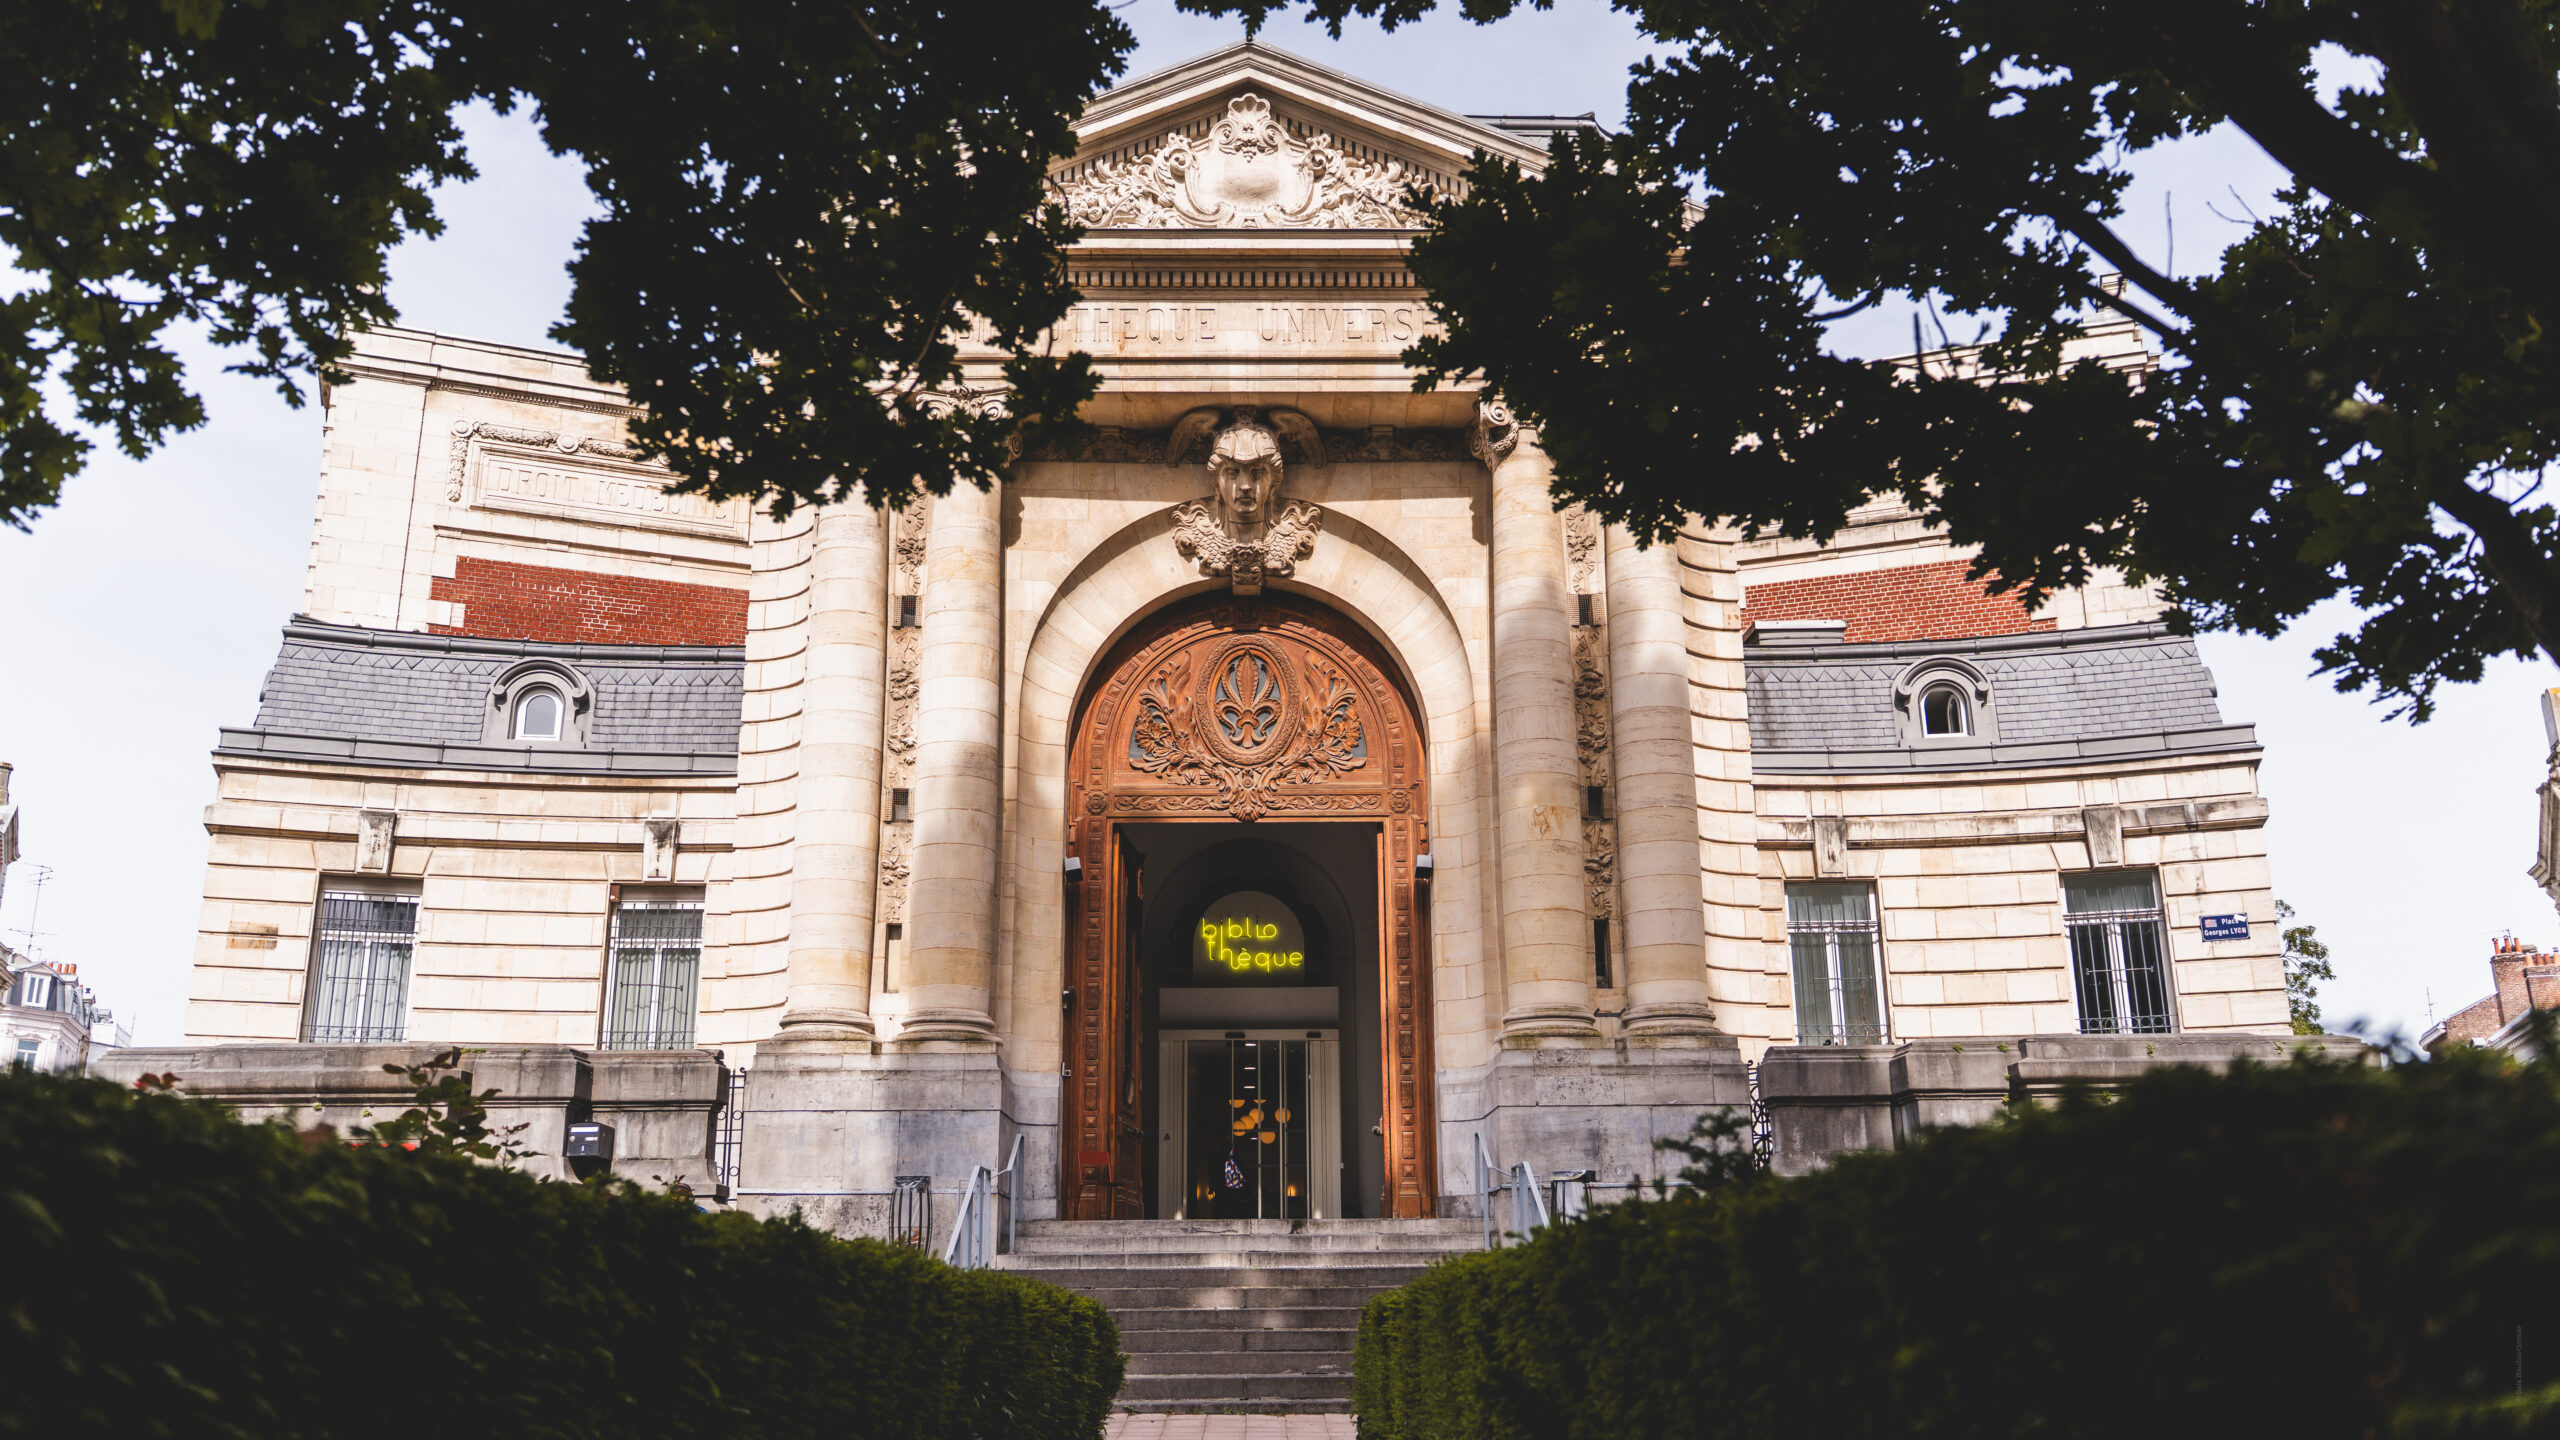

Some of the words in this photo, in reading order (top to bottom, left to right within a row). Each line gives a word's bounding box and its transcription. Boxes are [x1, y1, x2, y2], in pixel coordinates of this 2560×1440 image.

[496, 466, 579, 502] DROIT
[1202, 917, 1277, 938] biblio
[1207, 935, 1303, 973] thèque
